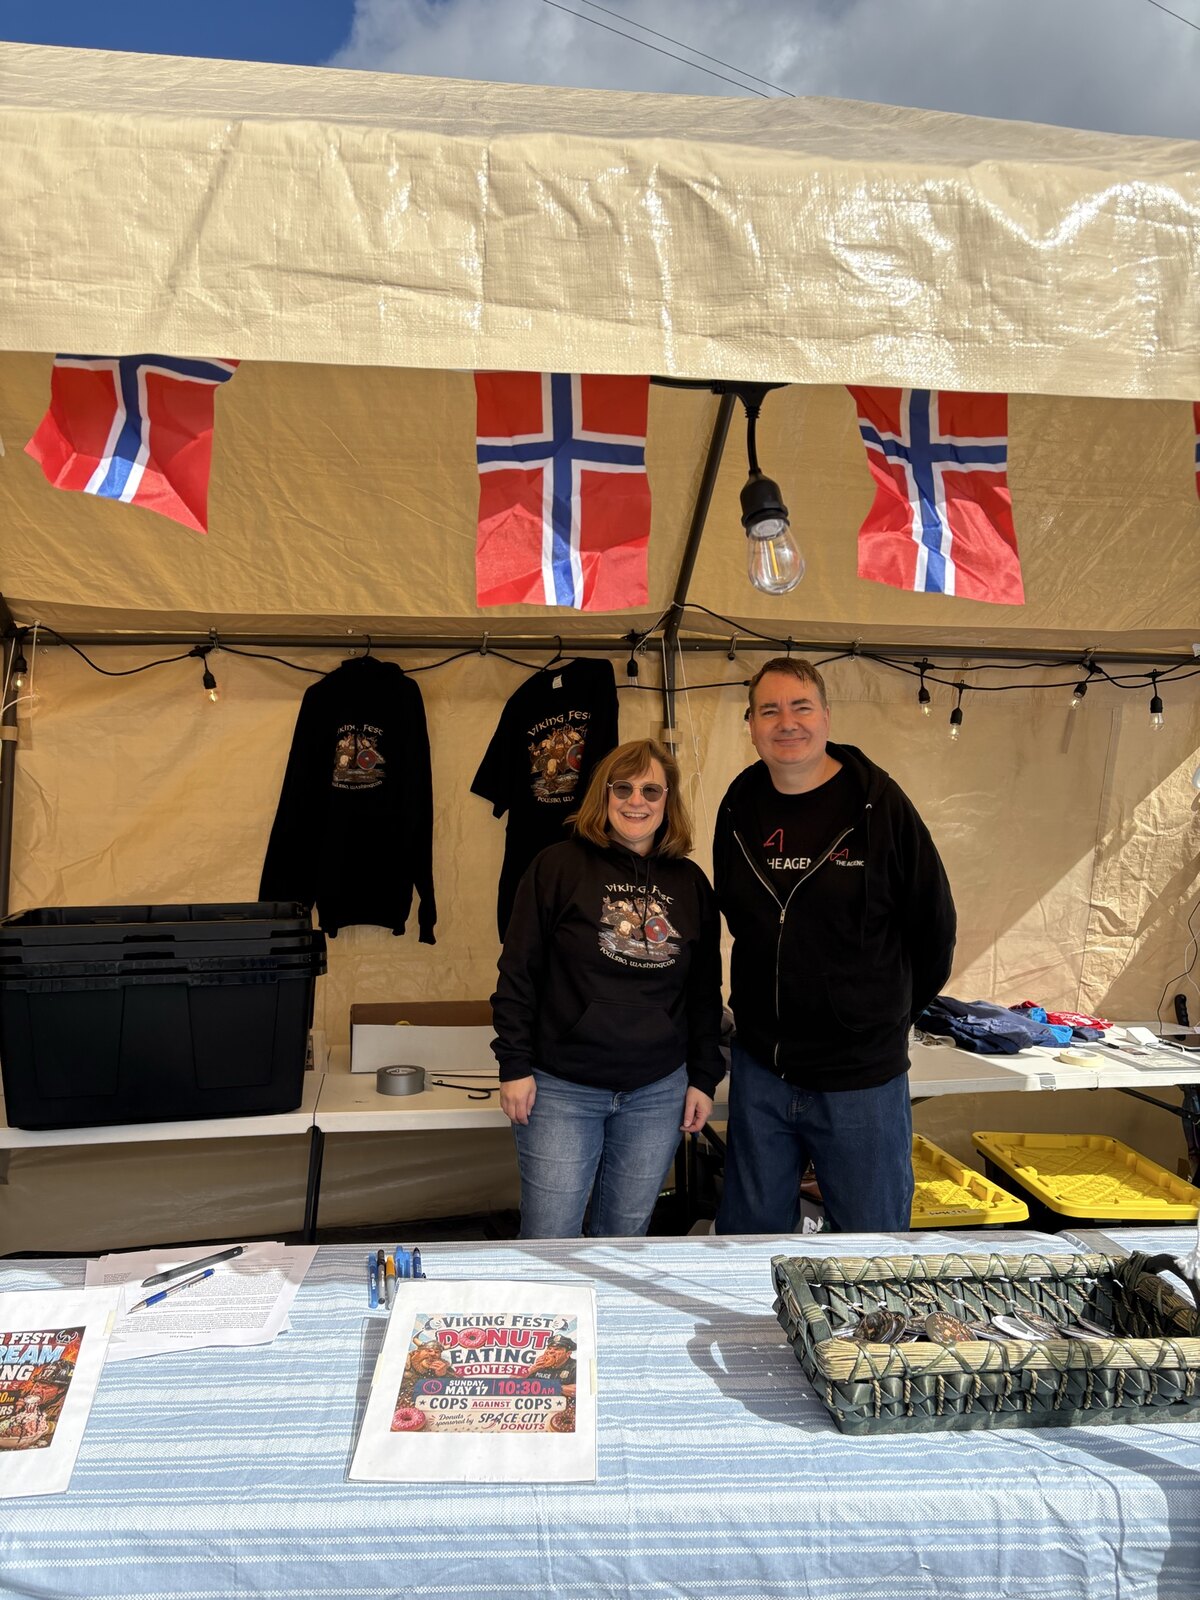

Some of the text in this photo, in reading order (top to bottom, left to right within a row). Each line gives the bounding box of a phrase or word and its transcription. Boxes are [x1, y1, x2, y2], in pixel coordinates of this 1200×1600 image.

[442, 1315, 553, 1328] VIKING FEST
[8, 1332, 55, 1345] FEST
[436, 1327, 552, 1349] DONUT
[0, 1344, 65, 1366] REAM
[450, 1349, 536, 1365] EATING
[464, 1365, 520, 1375] CONTEST
[535, 1372, 551, 1380] POLICE
[445, 1386, 488, 1395] MAY 17
[498, 1381, 541, 1395] 10:30
[430, 1397, 552, 1410] COPS AGAINST COPS
[435, 1418, 465, 1427] sponsored
[439, 1413, 463, 1421] Donuts
[478, 1412, 548, 1425] SPACE CITY
